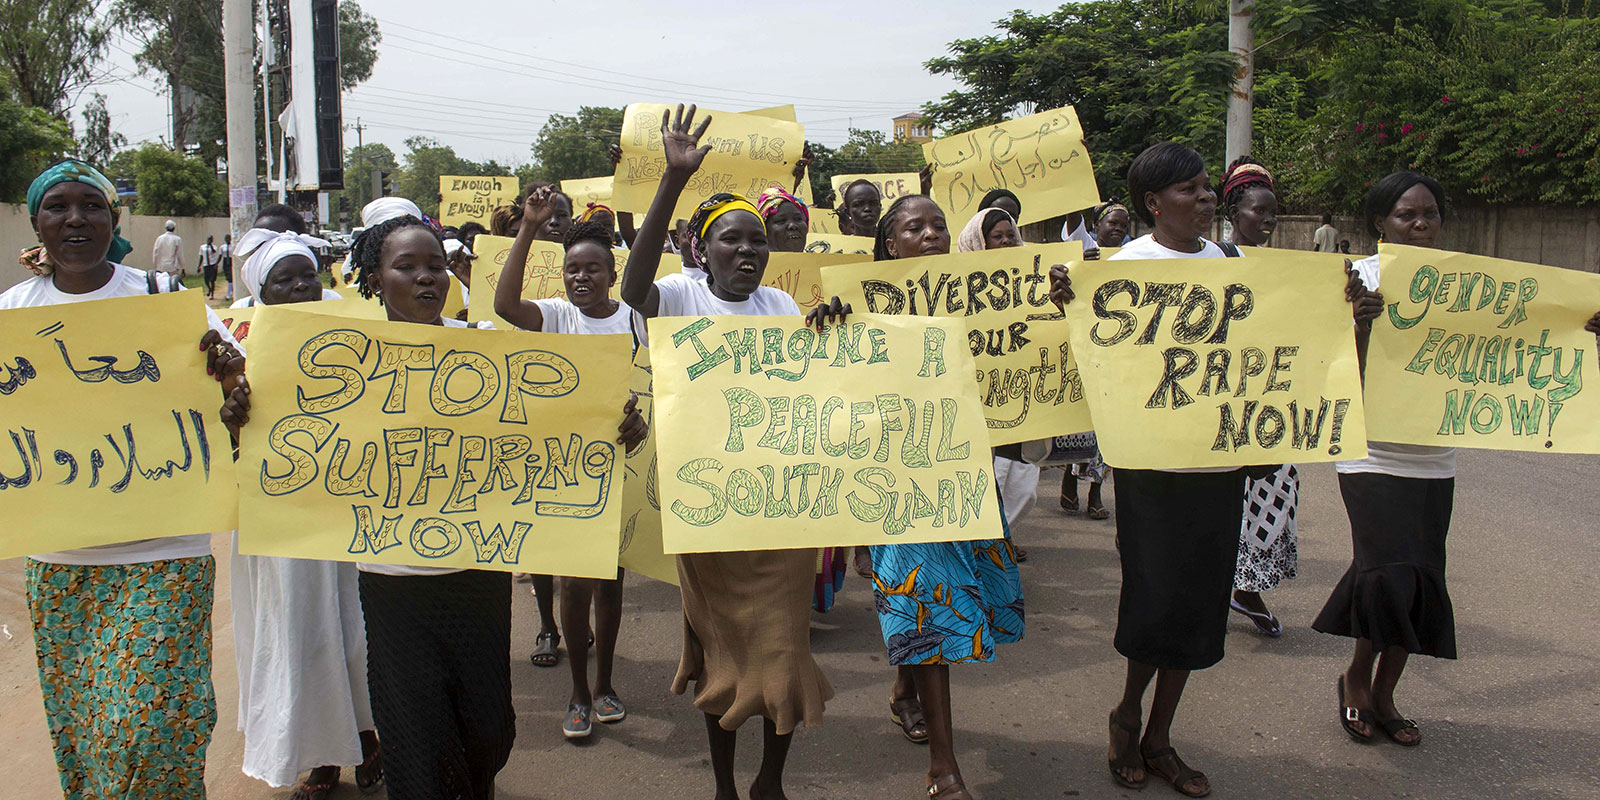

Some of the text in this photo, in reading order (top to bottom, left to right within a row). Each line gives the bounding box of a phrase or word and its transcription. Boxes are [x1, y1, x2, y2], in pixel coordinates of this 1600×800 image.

[1089, 279, 1254, 347] STOP
[296, 329, 580, 425] STOP
[917, 327, 947, 378] A
[1145, 346, 1300, 410] RAPE
[721, 387, 971, 469] PEACEFUL
[1211, 396, 1351, 456] NOW!
[1437, 389, 1564, 449] NOW!
[671, 458, 989, 535] SOUTH SUDAN
[347, 505, 533, 565] NOW
